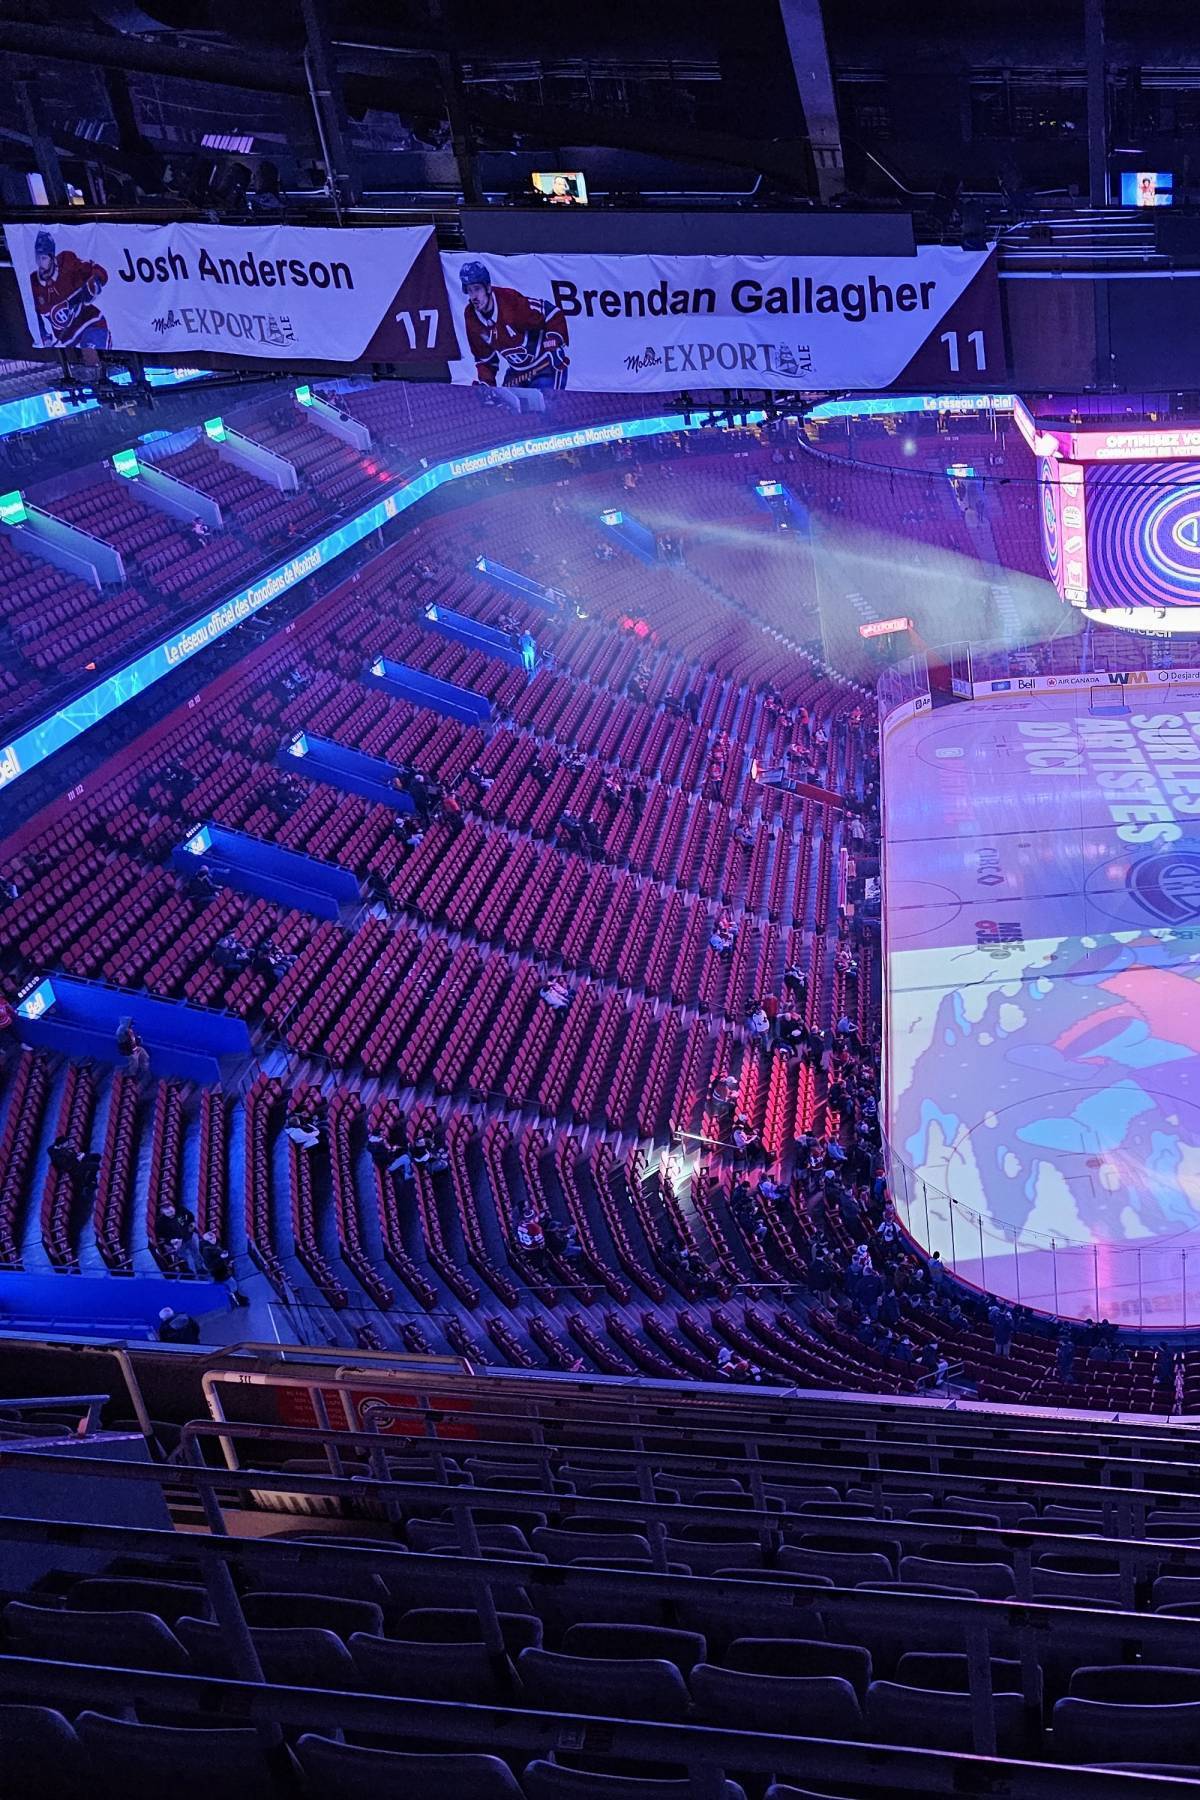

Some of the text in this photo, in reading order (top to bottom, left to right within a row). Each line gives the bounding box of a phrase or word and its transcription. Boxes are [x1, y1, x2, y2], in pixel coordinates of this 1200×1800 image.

[118, 247, 354, 290] Josh Anderson
[550, 275, 937, 324] Brendan Gallagher
[180, 308, 266, 344] EXPORT
[396, 309, 439, 350] 17
[662, 342, 776, 373] EXPORT
[798, 344, 812, 372] ALE
[940, 330, 986, 372] 11
[248, 579, 285, 608] Canadiens
[1018, 678, 1036, 690] Bell
[1074, 718, 1183, 844] ARTISTES
